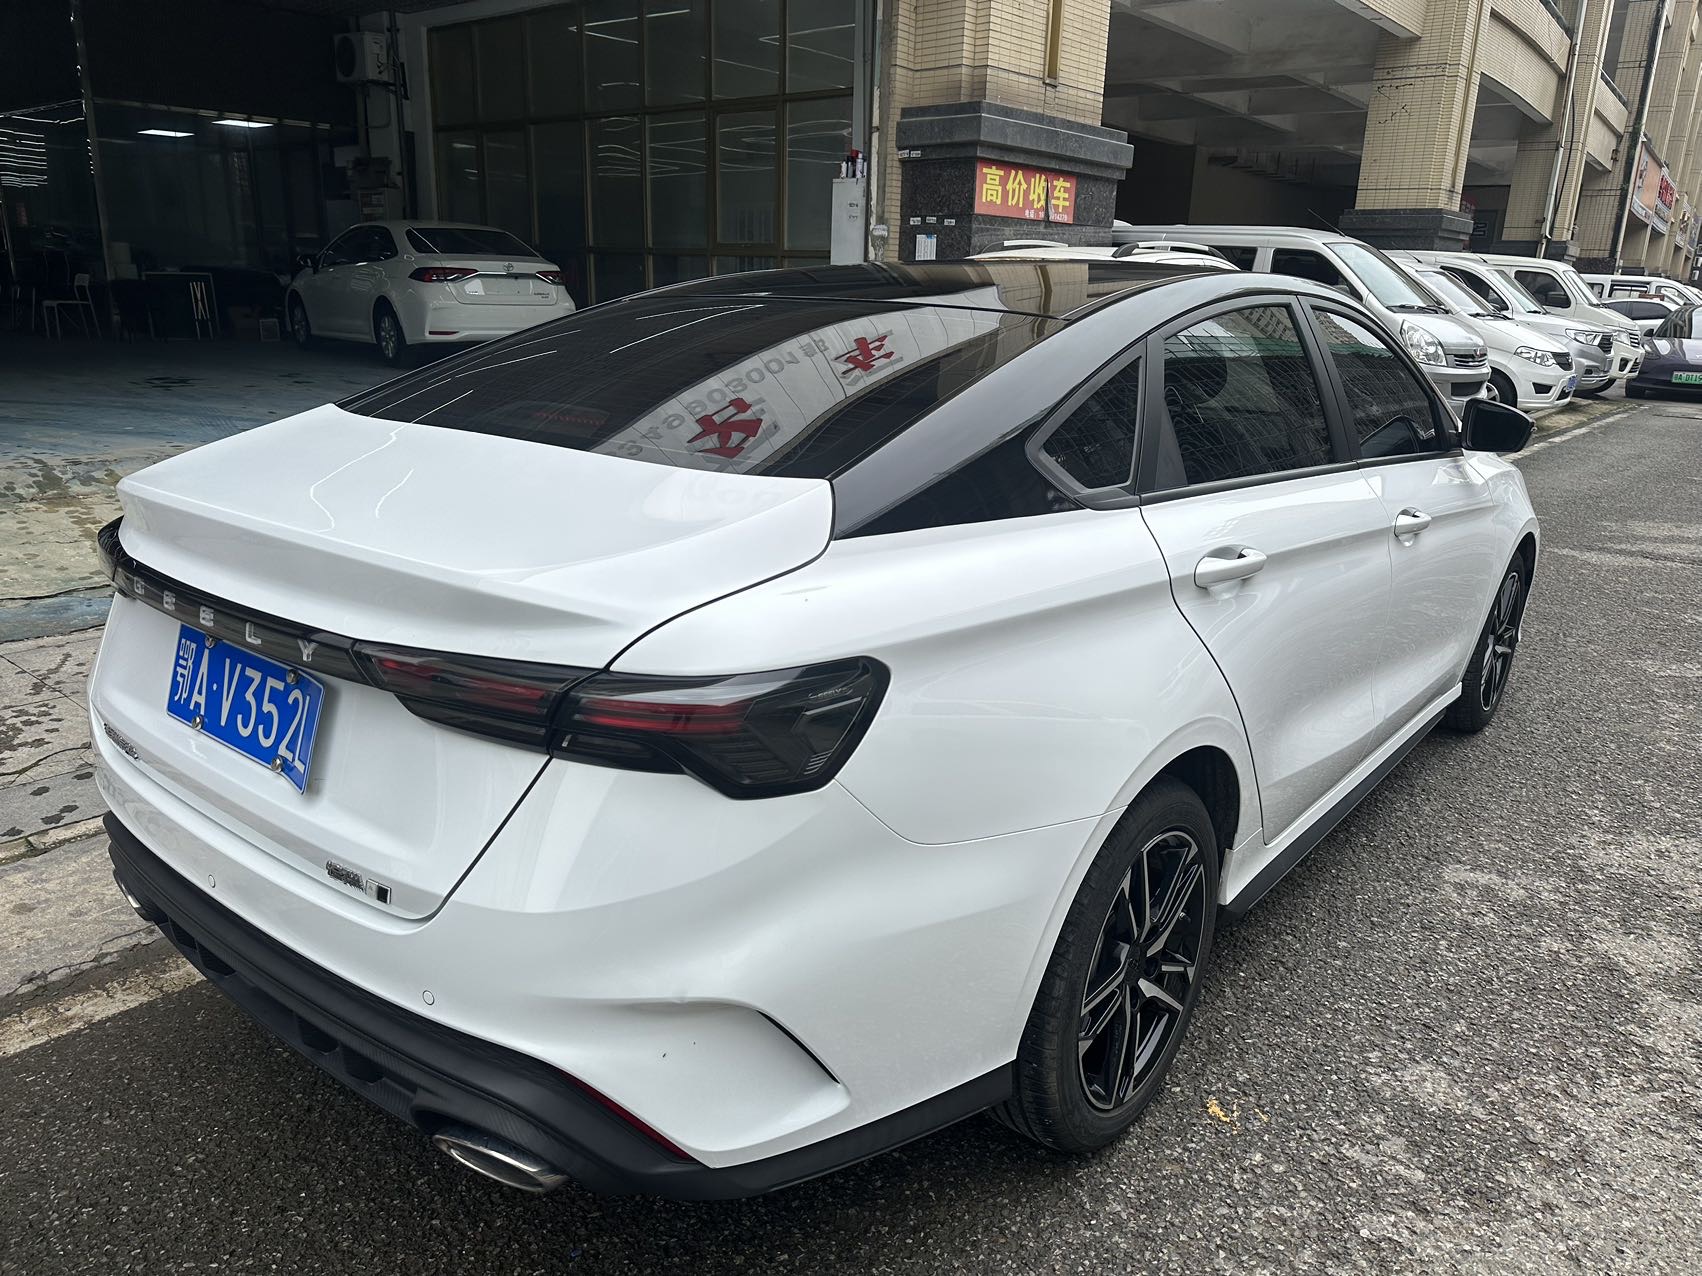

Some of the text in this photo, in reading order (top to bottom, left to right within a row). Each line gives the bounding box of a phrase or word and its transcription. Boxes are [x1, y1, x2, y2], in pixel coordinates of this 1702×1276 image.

[981, 165, 1071, 213] 高价收车
[133, 580, 319, 662] GEELY
